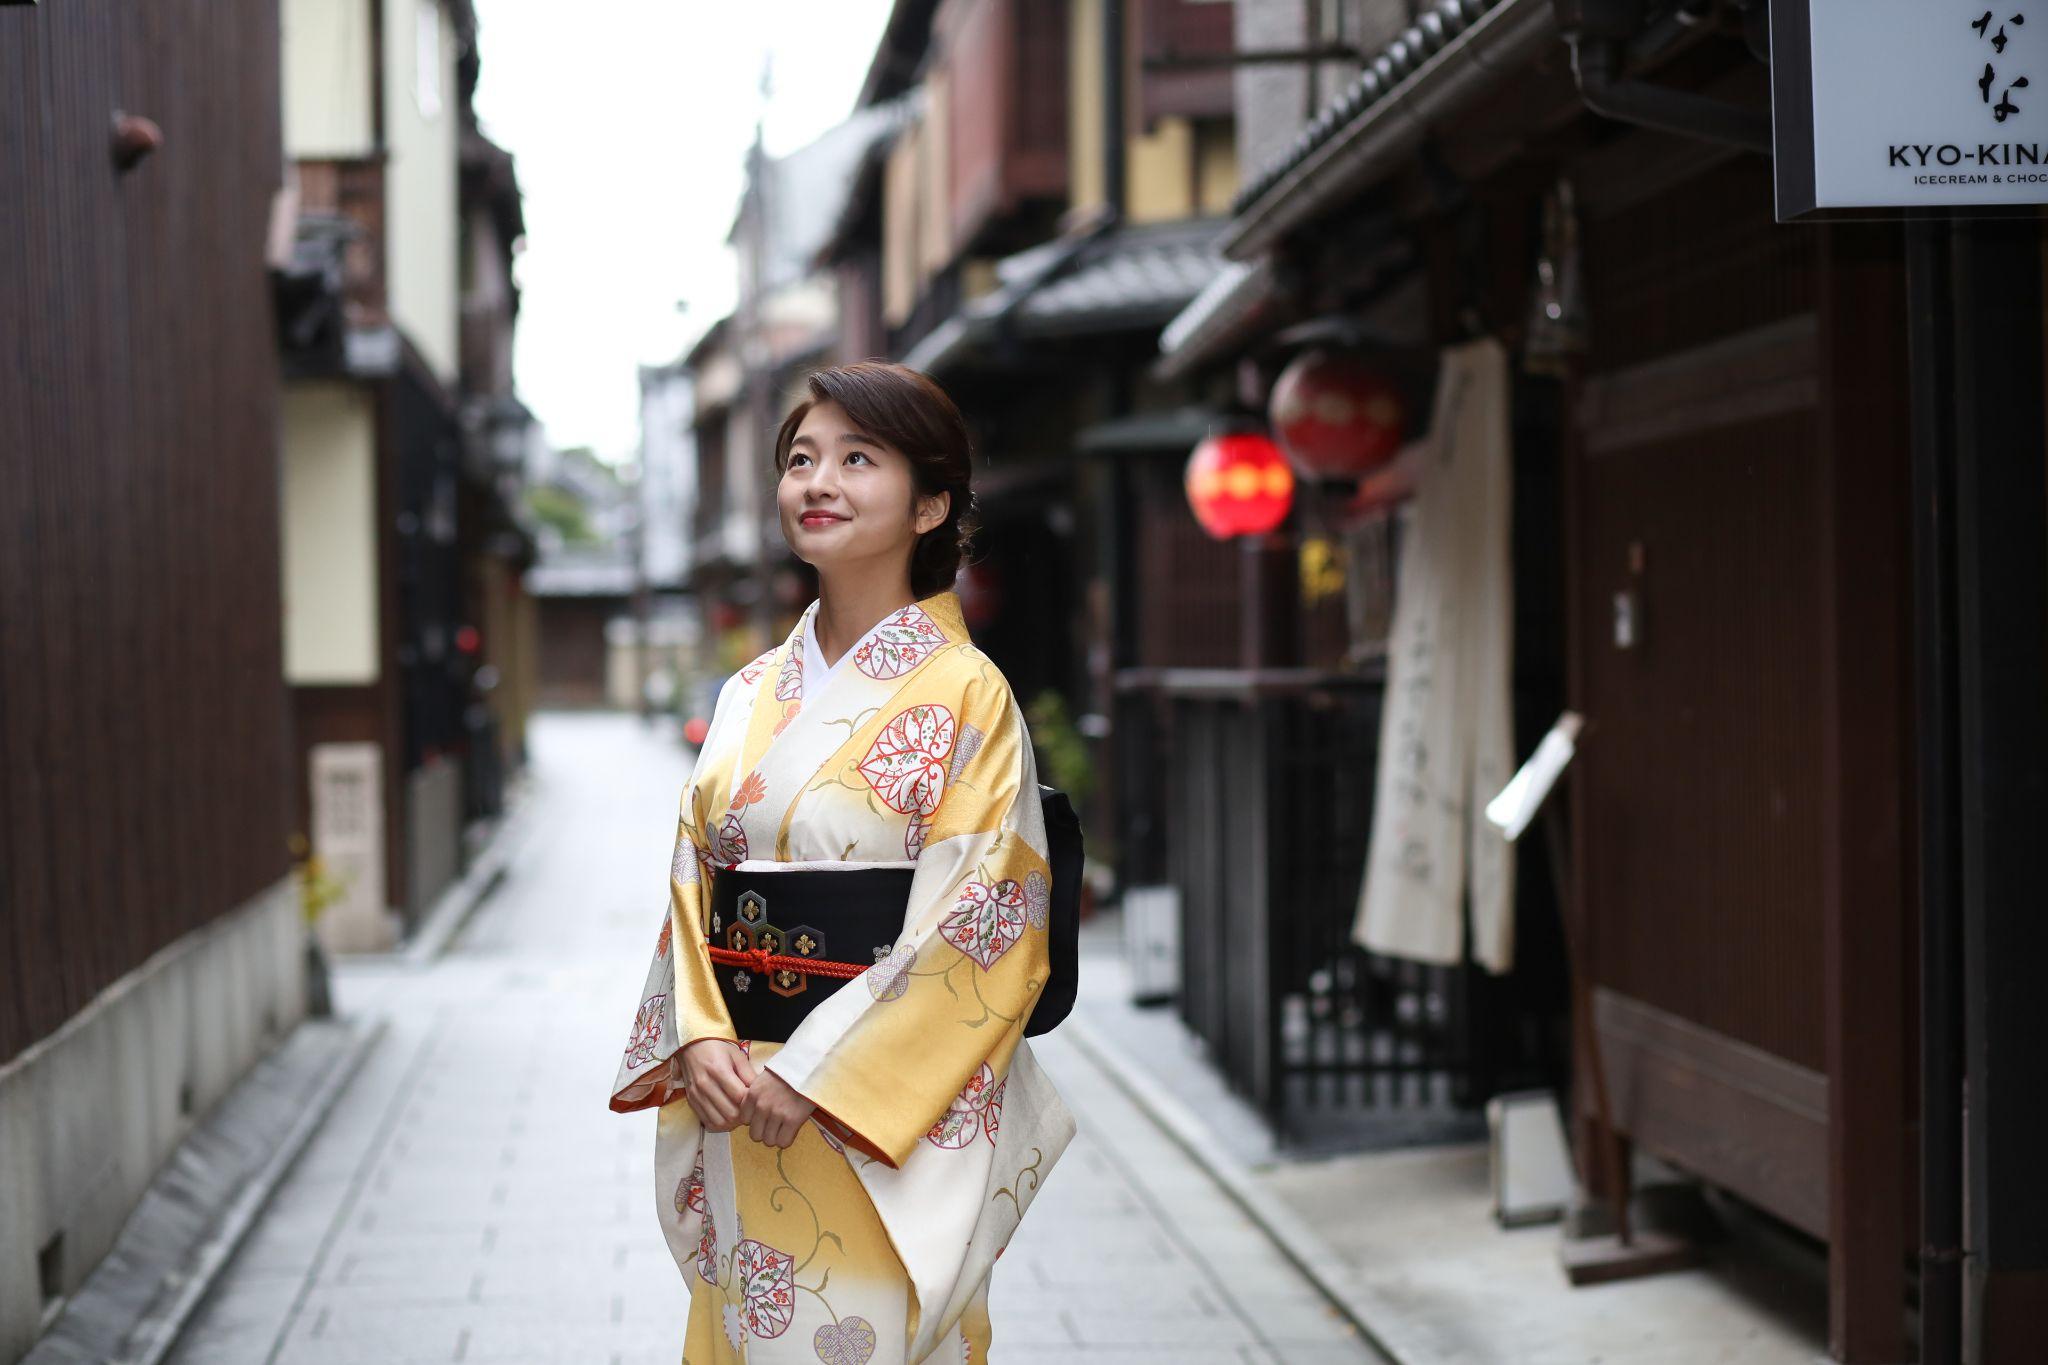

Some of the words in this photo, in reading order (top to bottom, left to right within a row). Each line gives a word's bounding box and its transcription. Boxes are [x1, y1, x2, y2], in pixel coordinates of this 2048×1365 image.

[1888, 143, 2048, 167] KYO-KIN
[1914, 174, 1988, 185] ICECREAM
[1992, 174, 2002, 184] &
